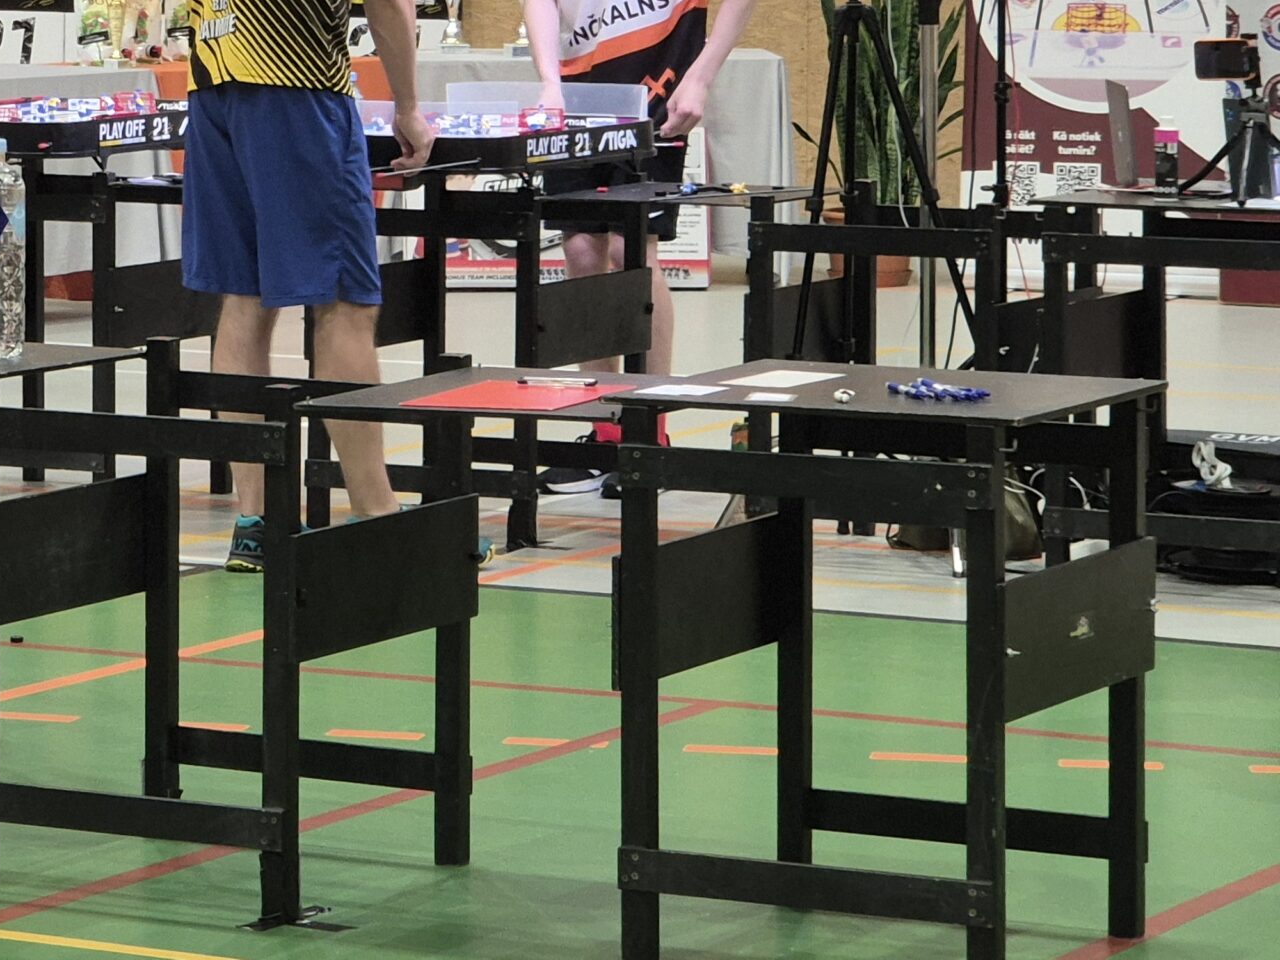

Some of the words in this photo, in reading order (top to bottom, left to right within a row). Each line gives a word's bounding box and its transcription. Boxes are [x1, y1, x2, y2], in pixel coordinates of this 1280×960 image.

[100, 121, 125, 141] PLAY
[125, 119, 146, 138] OFF
[153, 117, 169, 137] 21
[526, 138, 550, 157] PLAY
[550, 135, 569, 153] OFF
[575, 132, 590, 153] 21
[598, 129, 637, 153] STIGA
